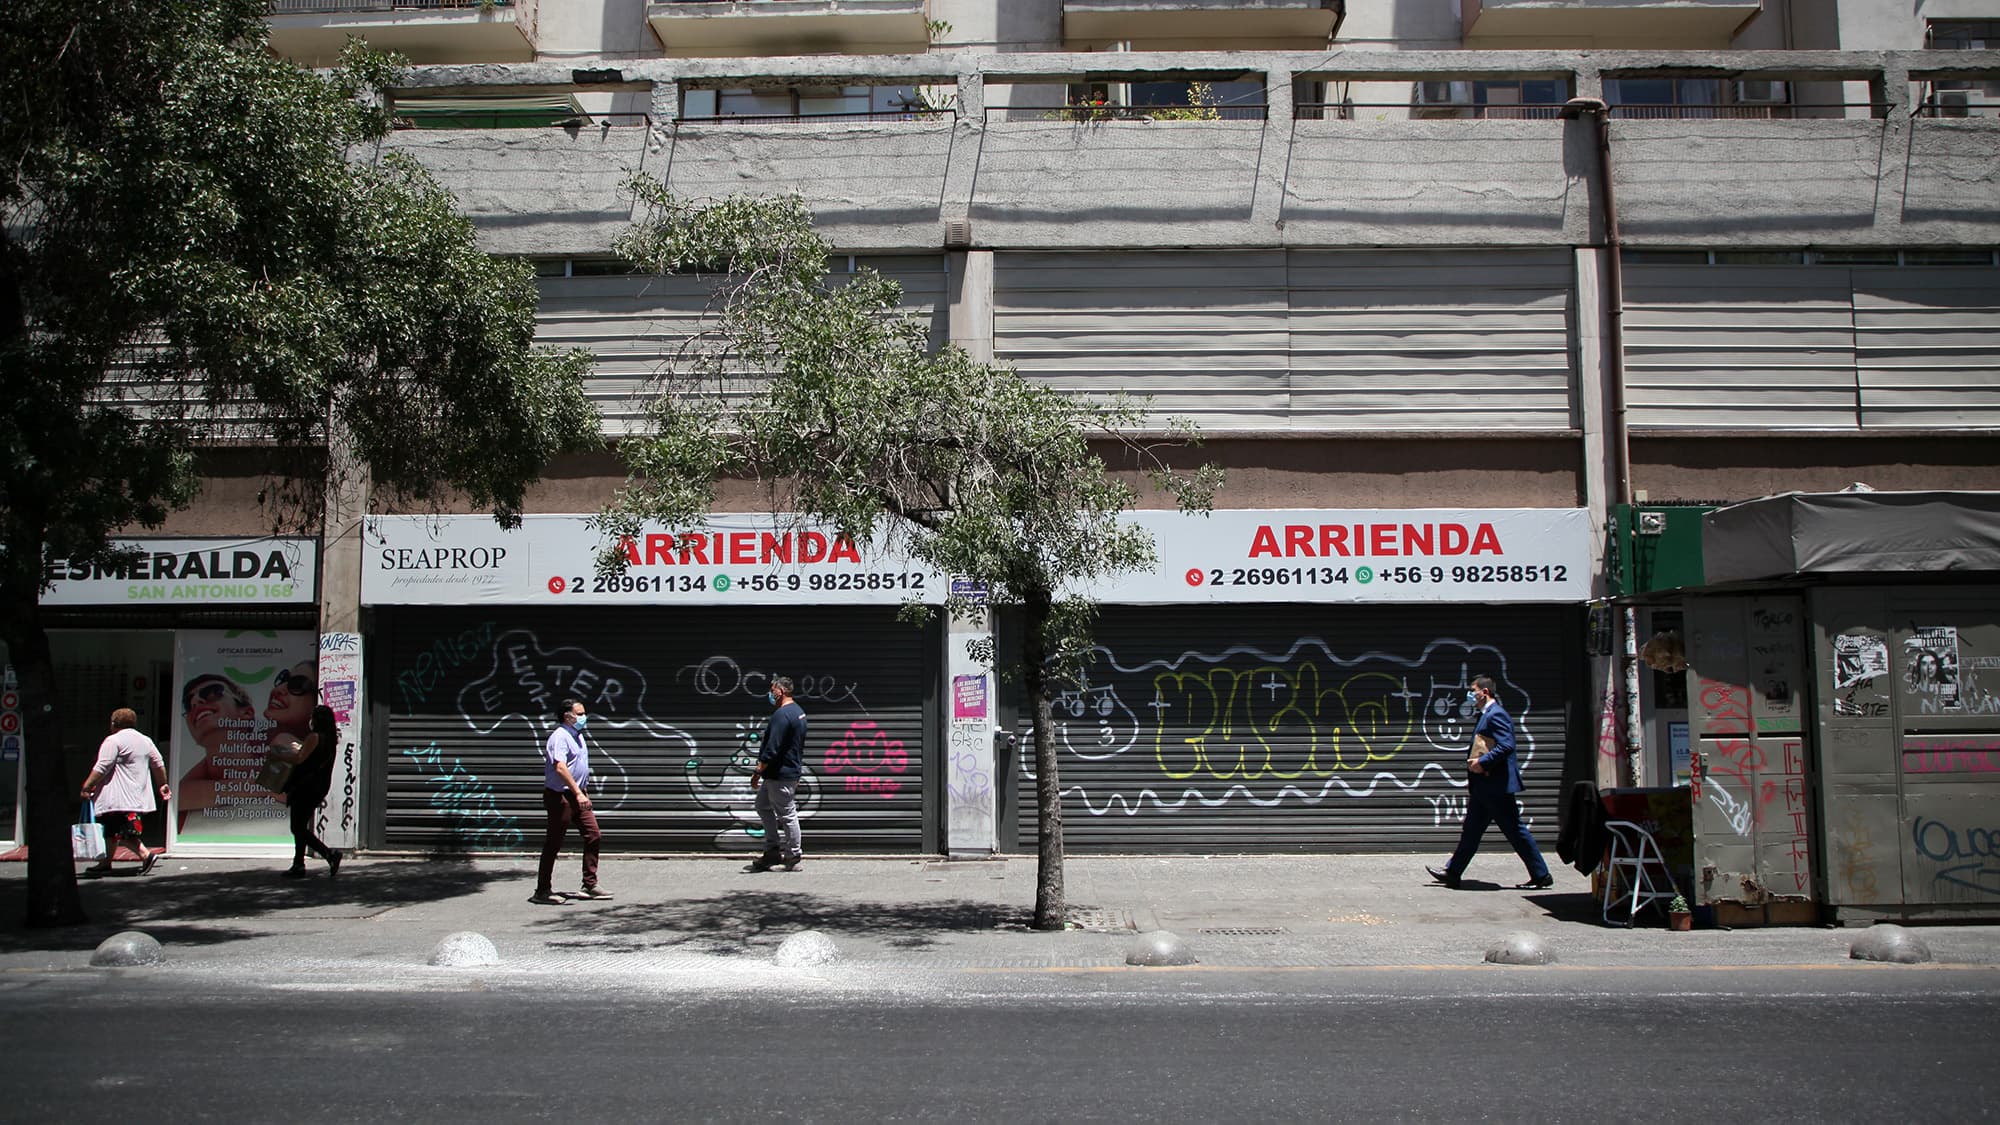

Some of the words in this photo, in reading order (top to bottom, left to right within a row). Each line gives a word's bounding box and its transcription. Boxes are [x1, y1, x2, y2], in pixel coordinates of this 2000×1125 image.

[1247, 522, 1504, 558] ARRIENDA
[608, 532, 862, 566] ARRIENDA
[381, 547, 507, 570] SEAPROP
[445, 574, 469, 584] desde
[737, 574, 779, 591] +56
[809, 572, 925, 590] 98258512
[1232, 567, 1349, 586] 26961134
[1379, 566, 1422, 585] +56
[1451, 564, 1567, 584] 98258512
[127, 585, 165, 599] SAN
[171, 585, 258, 599] ANTONIO
[263, 584, 293, 598] 168
[593, 575, 706, 593] 26961134
[227, 730, 268, 740] Bifocales
[219, 743, 271, 753] Multifocale
[223, 769, 247, 779] Filtro
[214, 782, 228, 791] De
[229, 781, 241, 791] Sol
[215, 795, 261, 806] Antiparras
[264, 795, 275, 805] de
[203, 807, 227, 817] Niños
[229, 810, 235, 820] y
[238, 807, 287, 819] Deportivos
